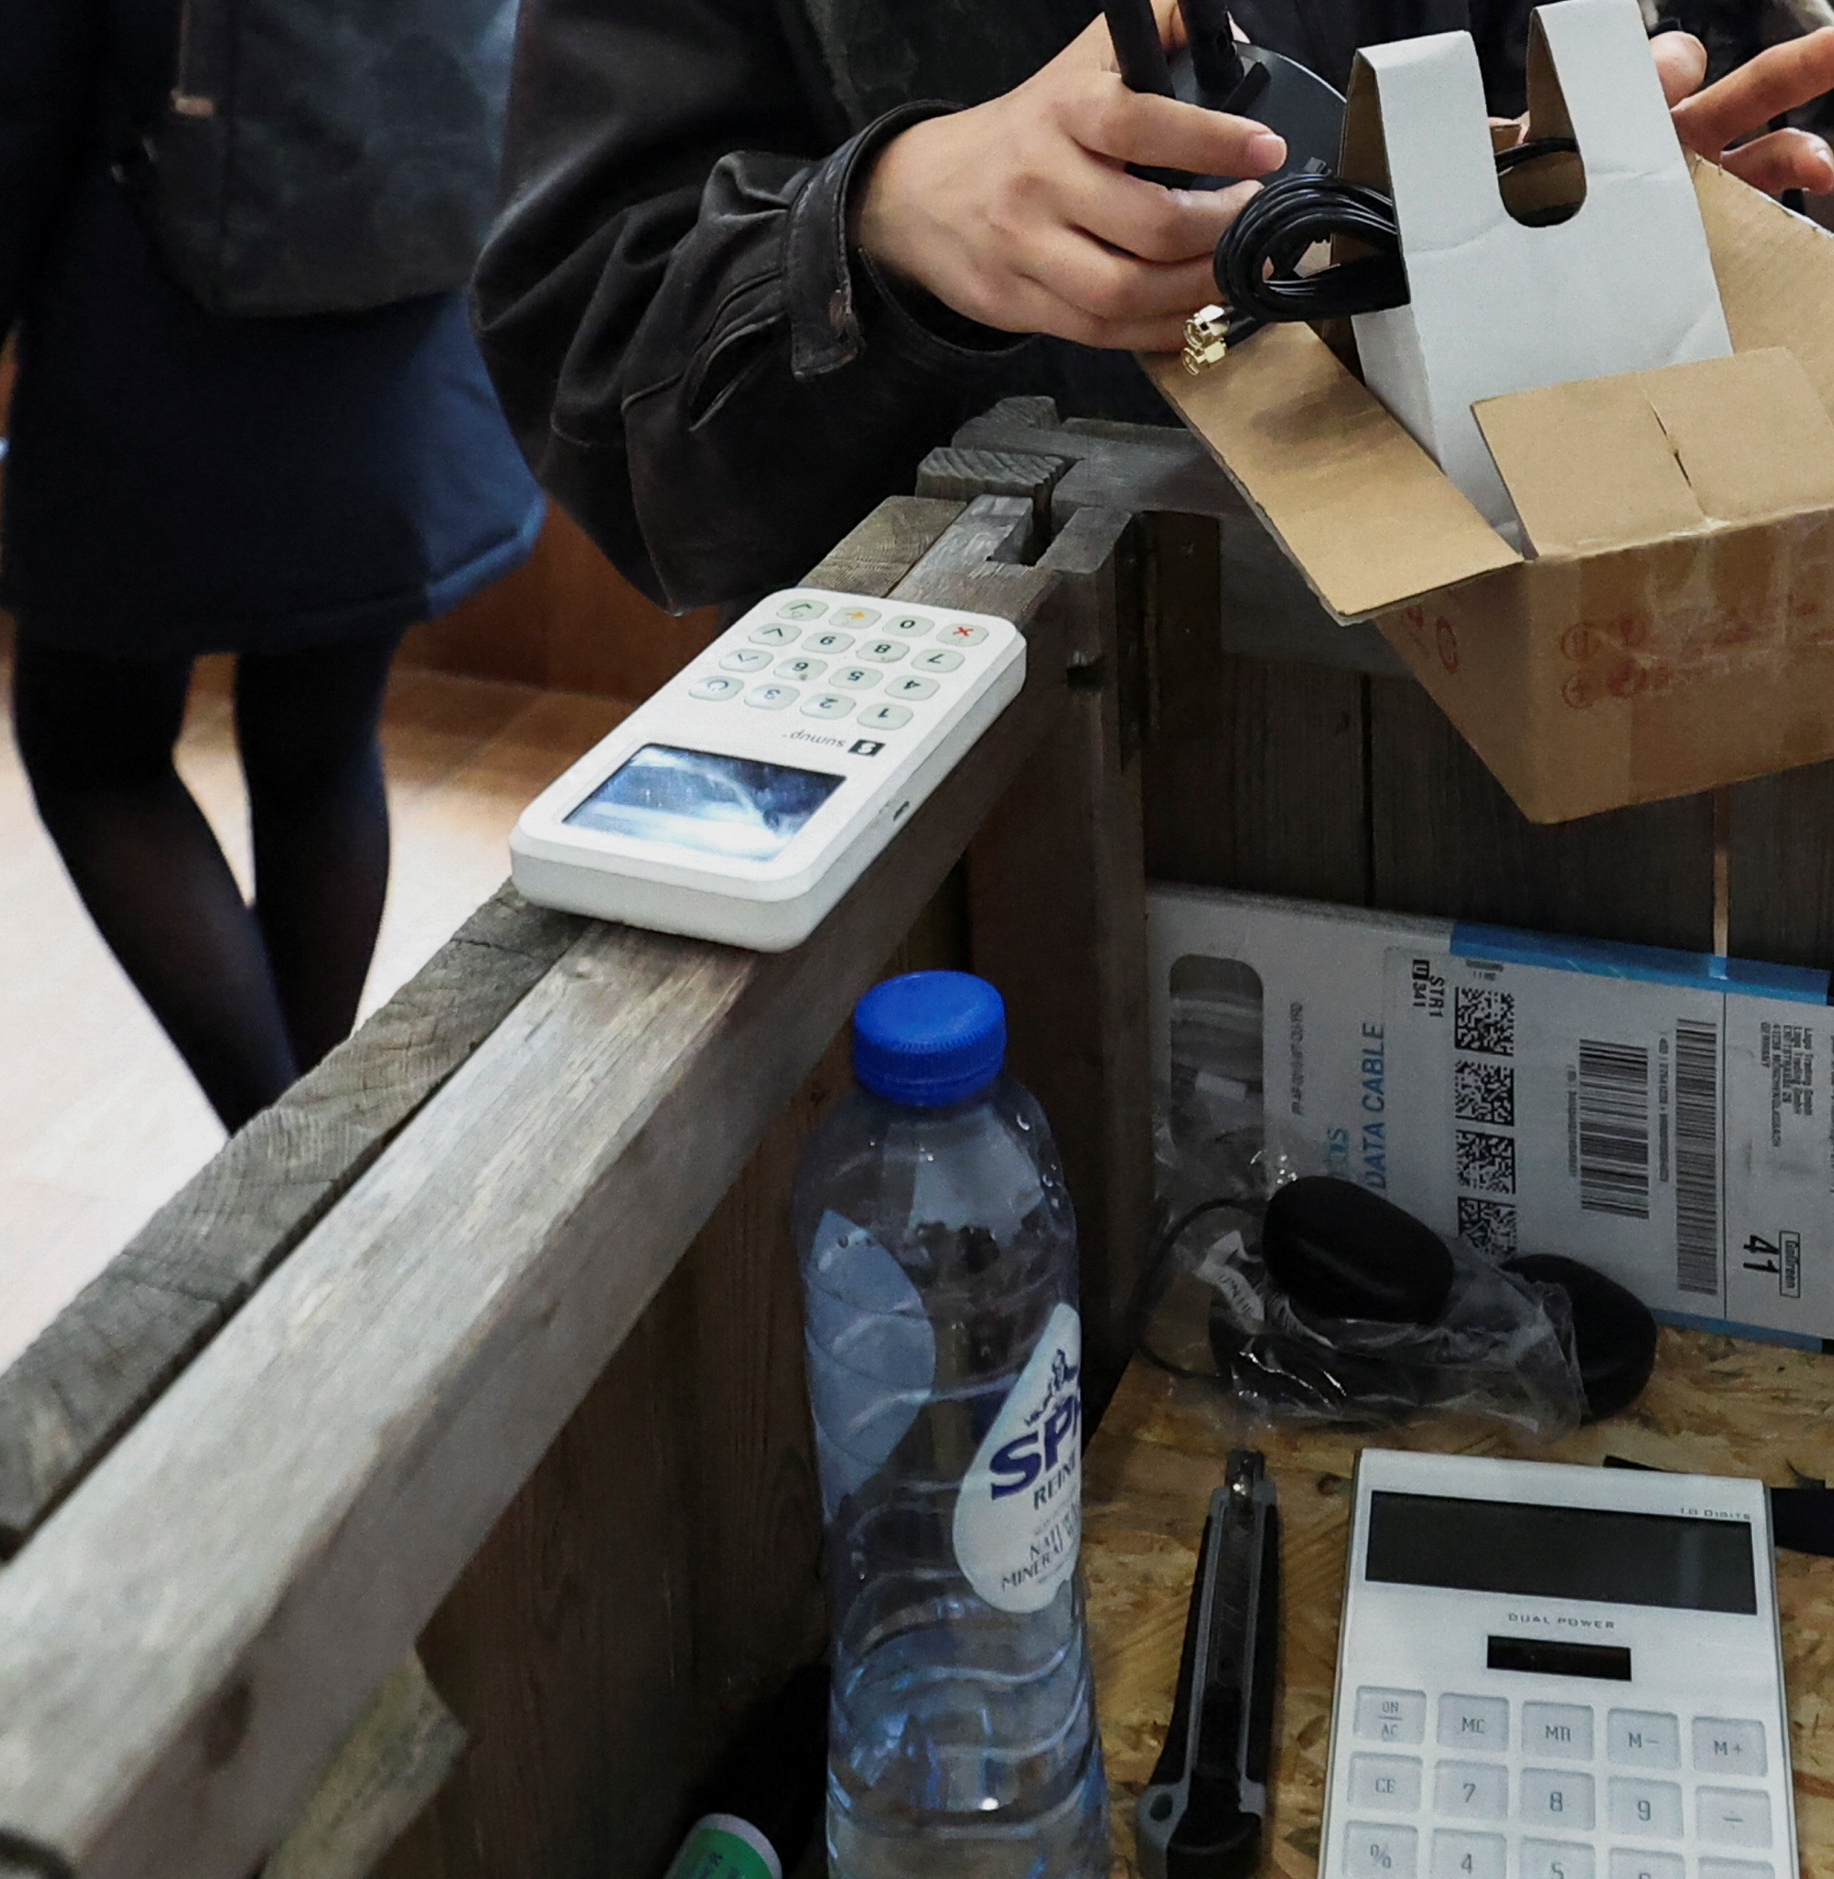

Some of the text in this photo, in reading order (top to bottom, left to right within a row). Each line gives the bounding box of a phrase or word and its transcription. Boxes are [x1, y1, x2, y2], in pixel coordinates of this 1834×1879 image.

[1413, 982, 1426, 1007] 341
[1429, 976, 1444, 1017] STR1
[1361, 1022, 1386, 1190] DATA CABLE
[1743, 1235, 1779, 1275] 41
[1462, 1783, 1476, 1804] 7
[1549, 1791, 1564, 1813] 8
[1637, 1800, 1652, 1822] 9
[1460, 1853, 1473, 1874] 4
